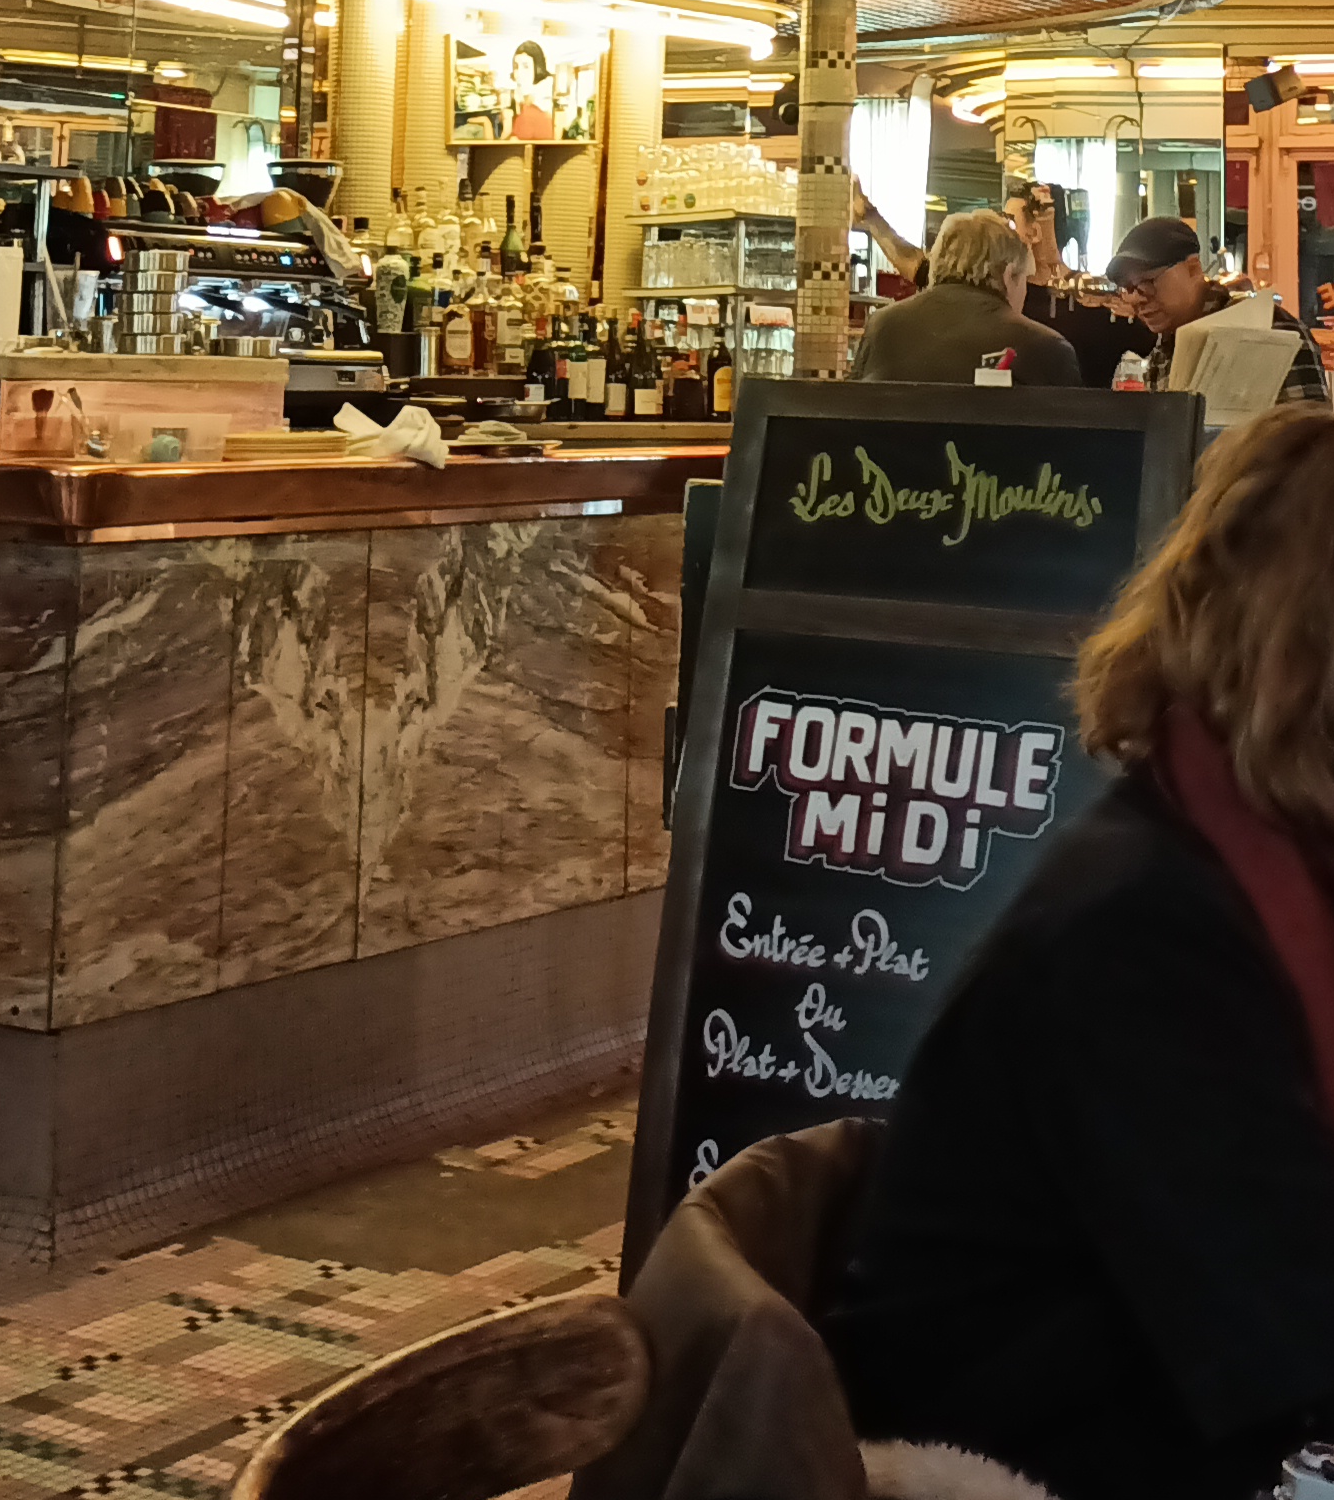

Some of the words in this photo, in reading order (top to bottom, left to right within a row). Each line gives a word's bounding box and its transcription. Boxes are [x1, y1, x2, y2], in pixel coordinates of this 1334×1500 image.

[789, 452, 855, 522] Les
[855, 446, 955, 525] Deux
[942, 441, 1094, 546] Moulins
[748, 700, 1056, 811] FORMULE
[720, 891, 827, 968] Entrée
[851, 909, 930, 982] Plat
[794, 982, 848, 1032] Ou
[703, 1008, 777, 1080] Plat
[803, 1031, 900, 1100] Desser
